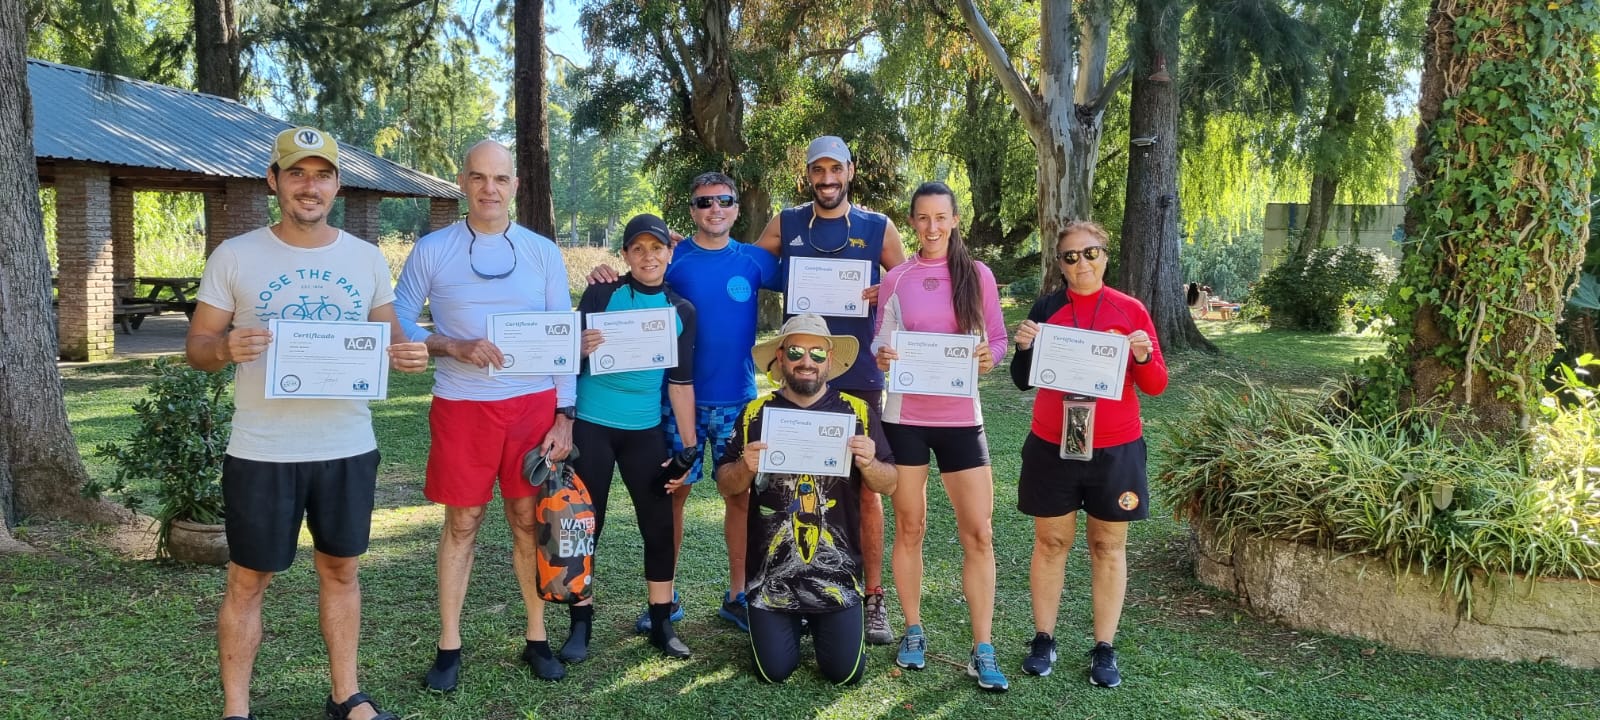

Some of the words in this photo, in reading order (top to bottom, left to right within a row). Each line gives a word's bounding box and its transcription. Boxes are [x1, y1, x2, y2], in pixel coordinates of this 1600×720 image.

[840, 272, 859, 280] ACA
[255, 274, 292, 309] LOSE
[296, 269, 332, 281] THE
[336, 276, 362, 309] PATH
[547, 325, 568, 335] ACA
[643, 320, 664, 331] ACA
[293, 332, 335, 340] Certificado
[346, 338, 374, 350] ACA
[946, 347, 968, 358] ACA
[1093, 345, 1115, 358] ACA
[820, 426, 842, 437] ACA
[560, 517, 595, 529] WATER
[559, 539, 594, 558] BAG
